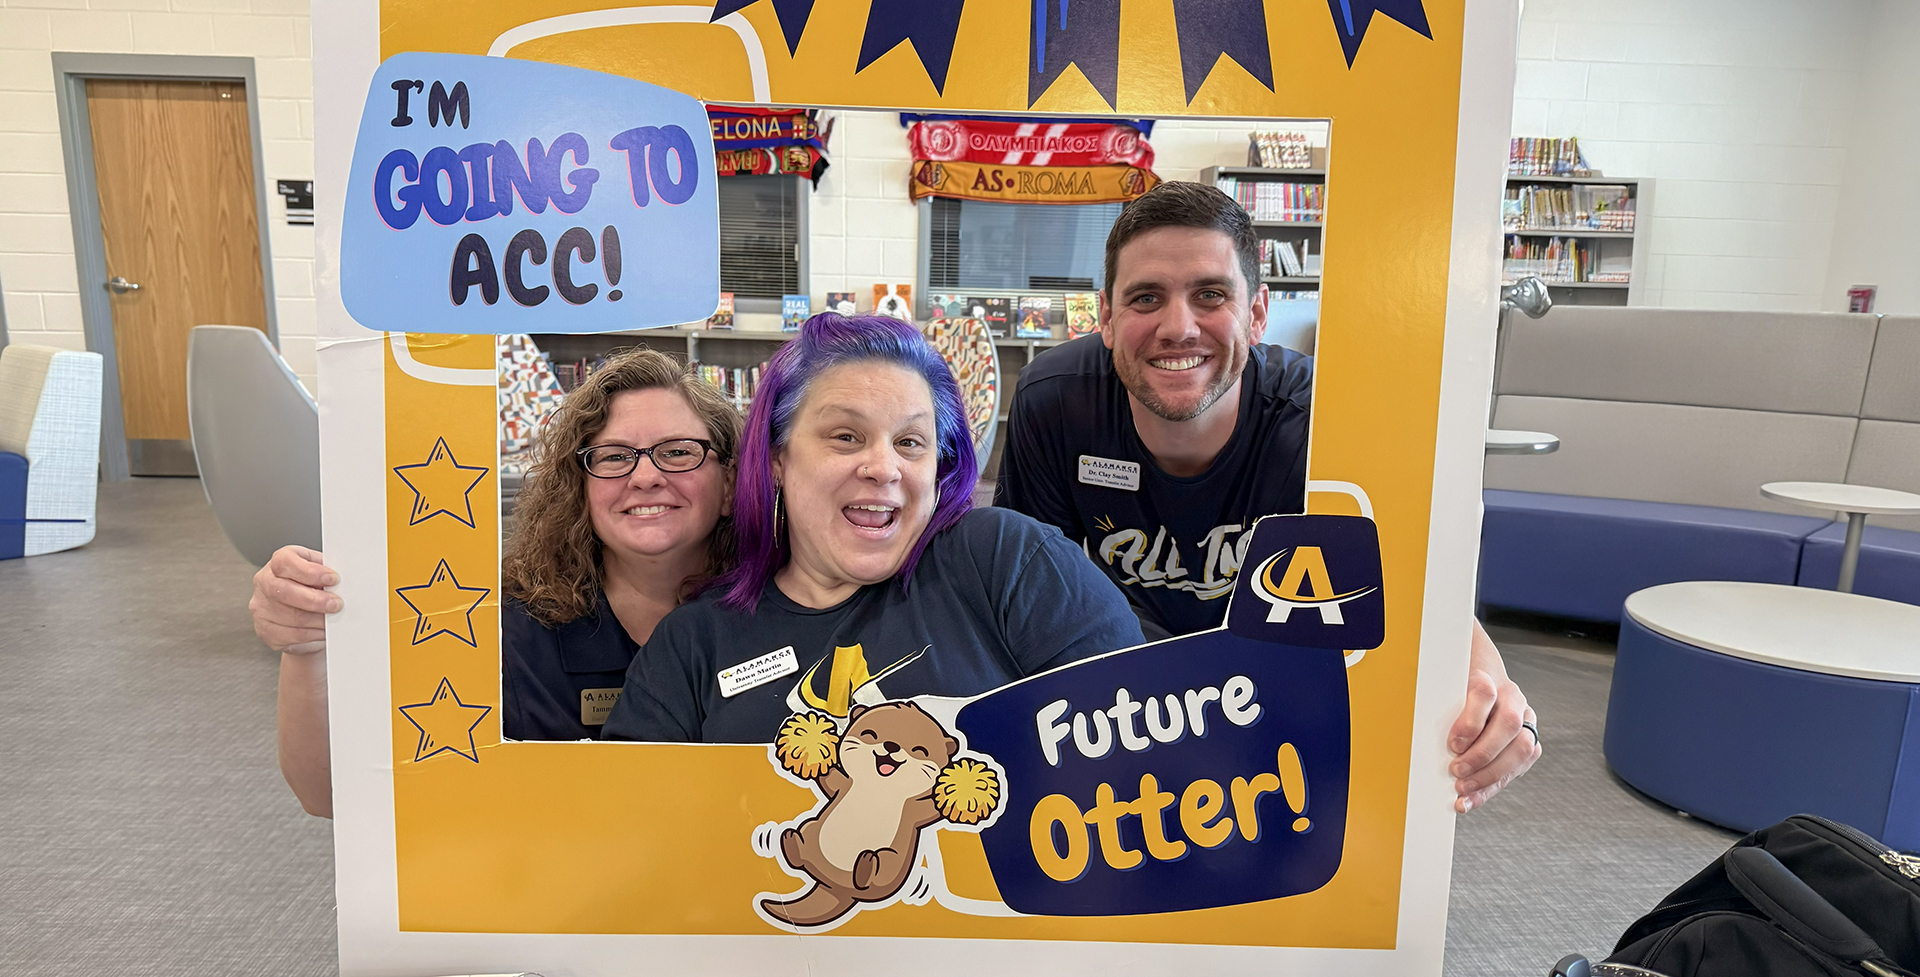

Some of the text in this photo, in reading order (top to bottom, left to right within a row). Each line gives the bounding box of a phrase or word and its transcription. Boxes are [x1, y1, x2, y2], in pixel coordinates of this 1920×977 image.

[391, 79, 470, 130] I'M
[711, 117, 781, 139] ELONA
[969, 133, 1099, 153] ΟΛΥΜΠΙΑΚΟΣ
[372, 124, 698, 231] GOING TO
[1017, 171, 1097, 195] ROMA
[449, 224, 623, 307] ACC!
[735, 663, 782, 683] Dawn Martin
[1036, 675, 1264, 766] Future
[1029, 742, 1314, 883] Otter!
